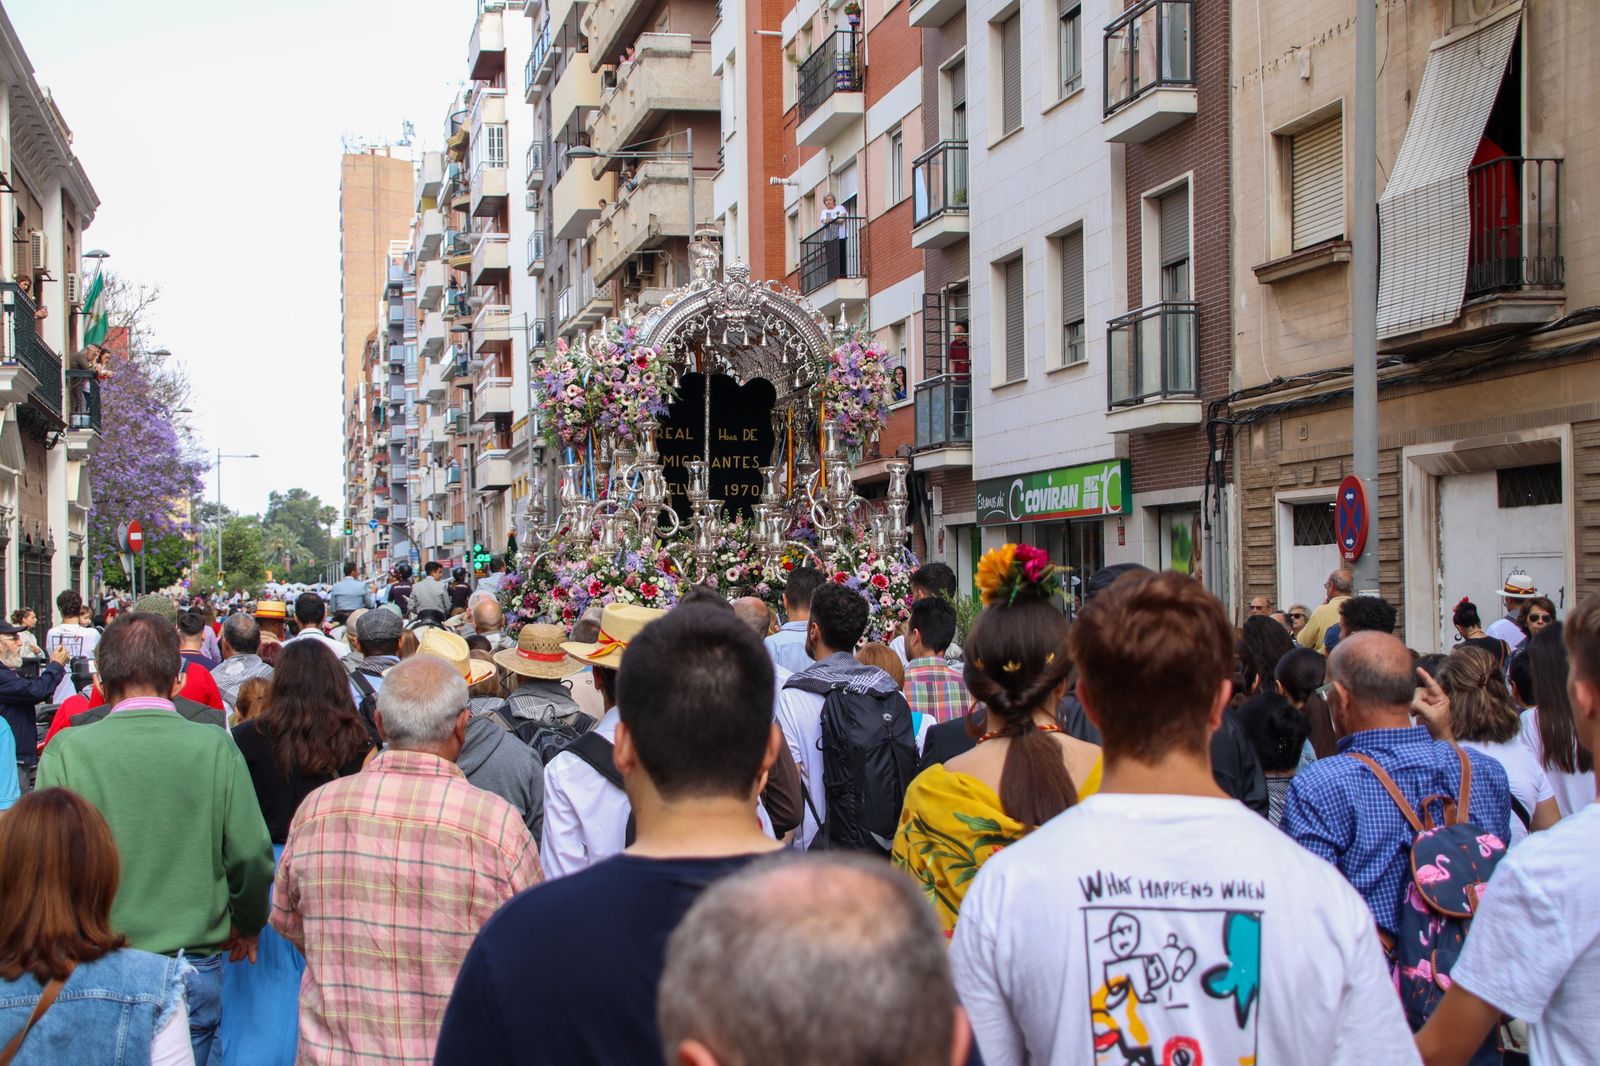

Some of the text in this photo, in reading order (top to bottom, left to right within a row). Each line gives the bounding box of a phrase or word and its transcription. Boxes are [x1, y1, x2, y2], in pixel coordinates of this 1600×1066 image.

[743, 428, 758, 441] DE
[724, 483, 760, 497] 1970
[1138, 879, 1214, 899] HAPPENS
[1220, 880, 1266, 900] WHEN
